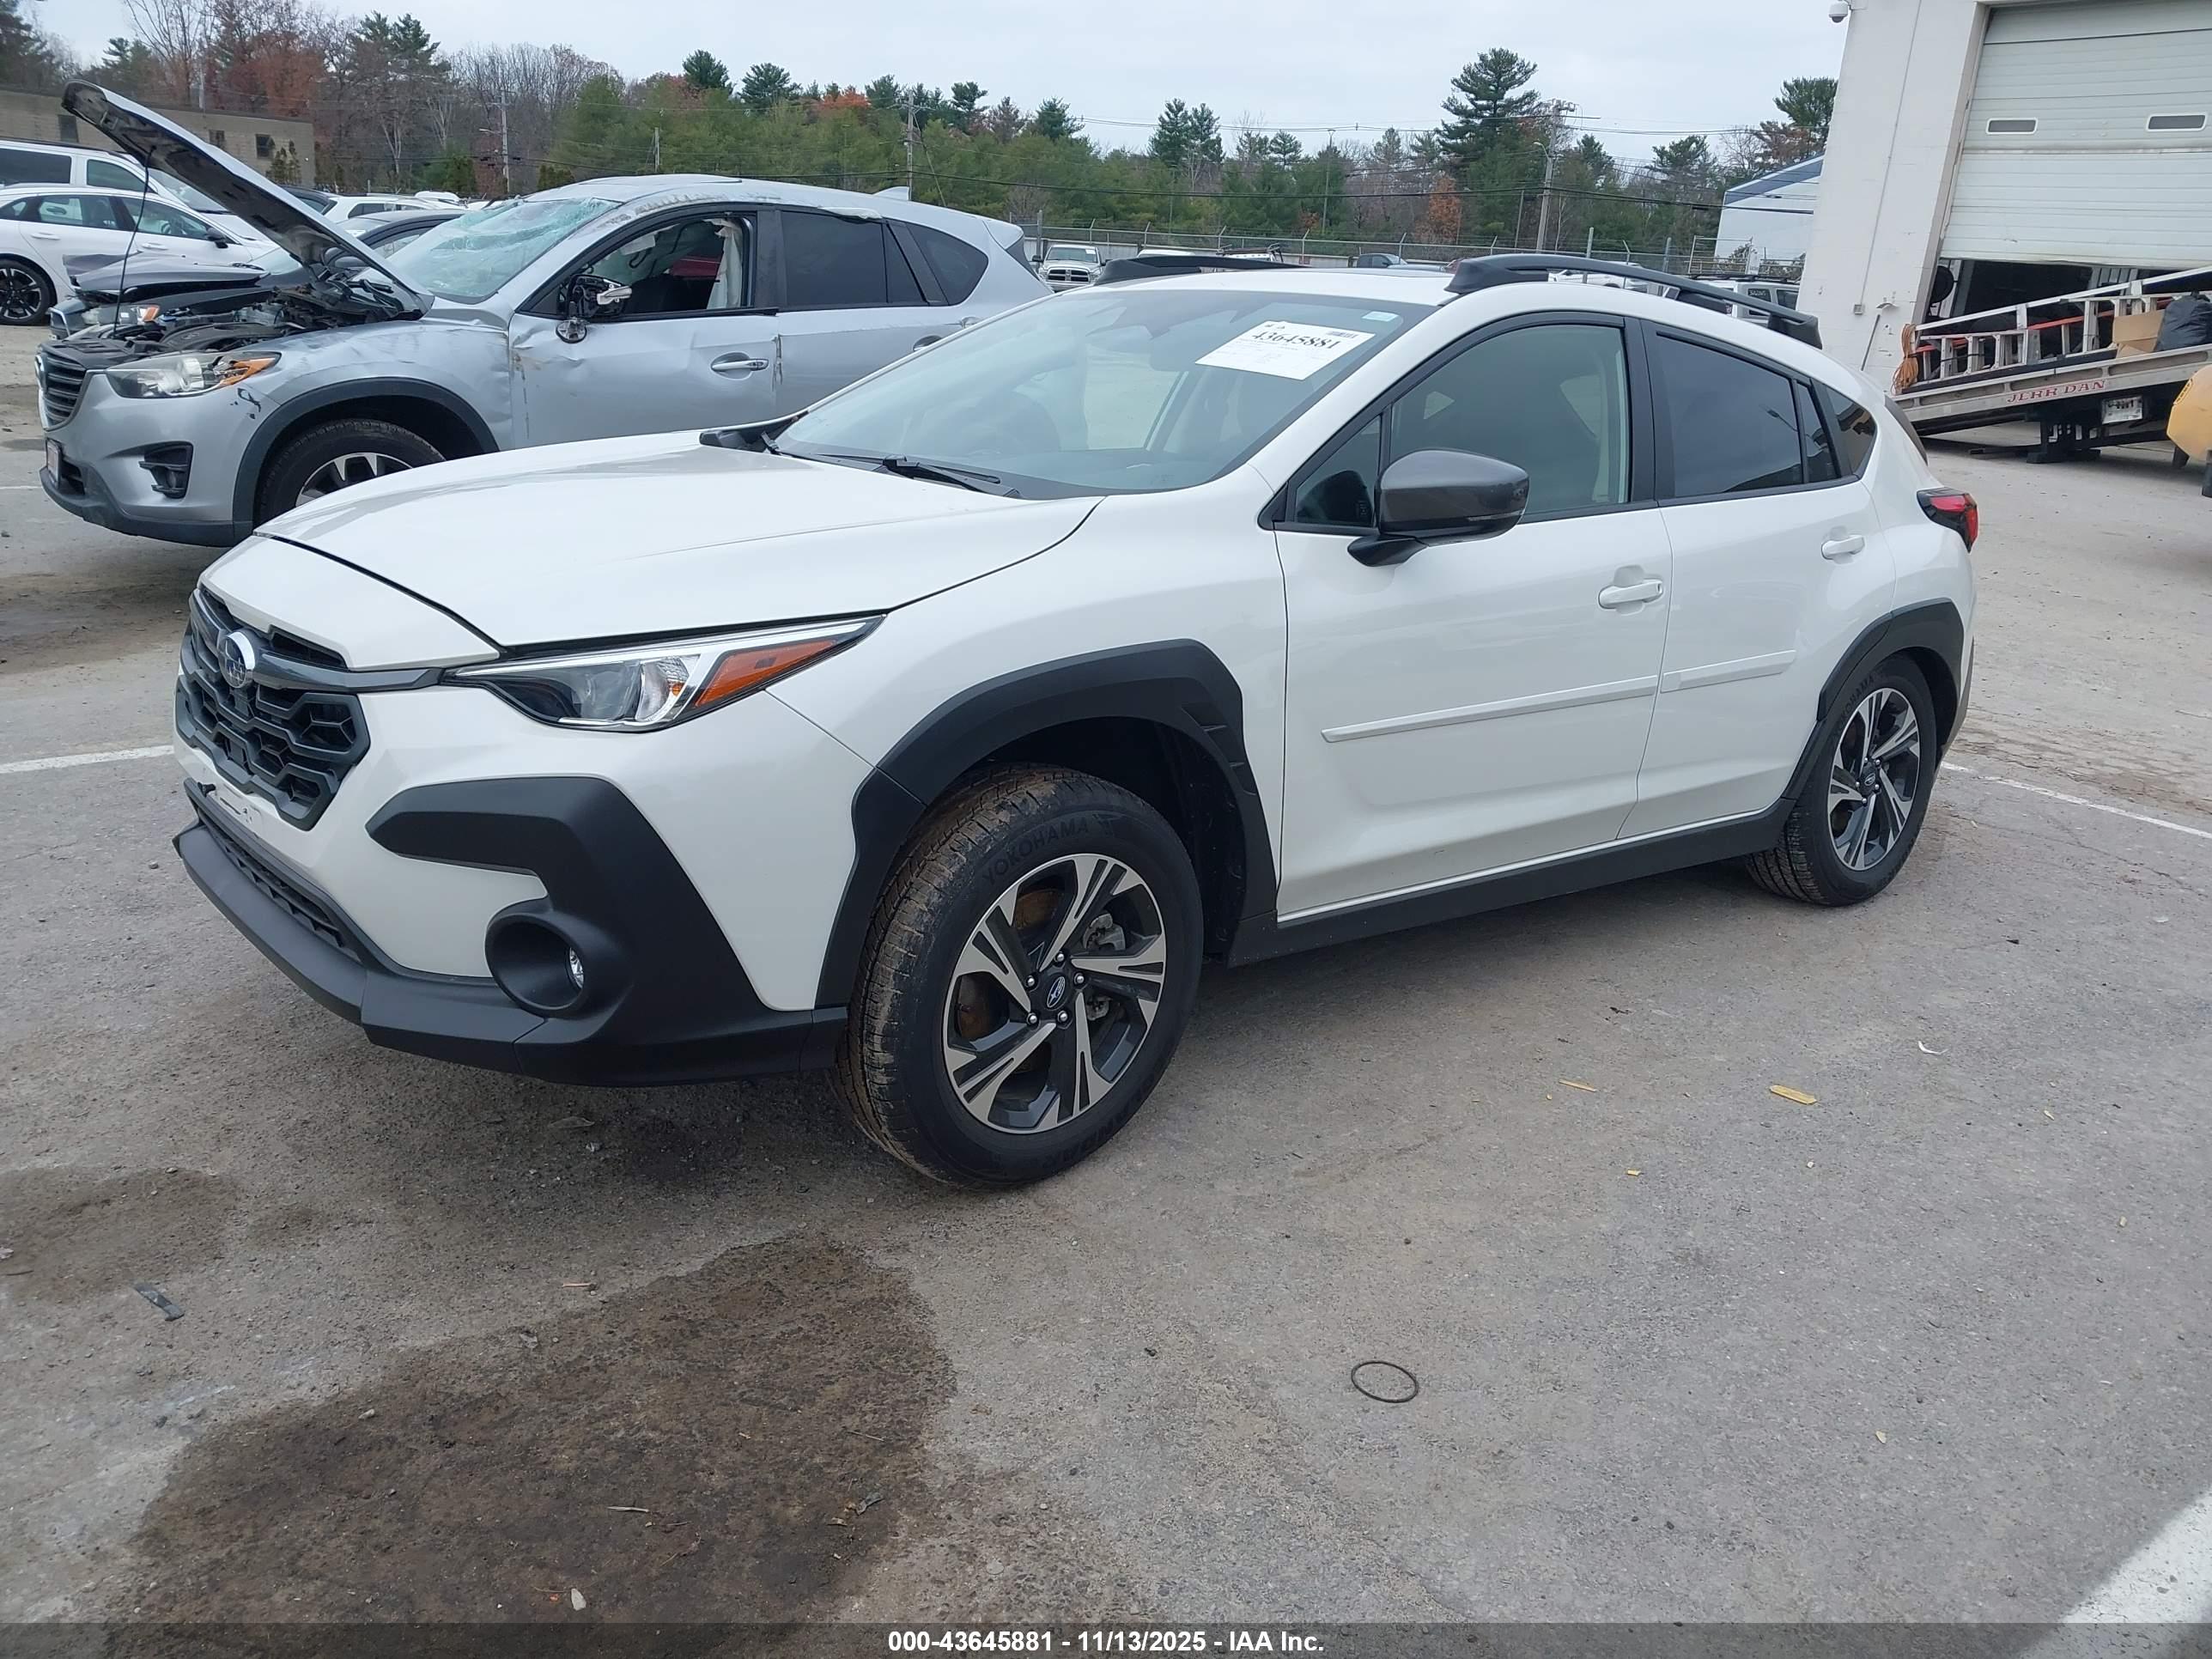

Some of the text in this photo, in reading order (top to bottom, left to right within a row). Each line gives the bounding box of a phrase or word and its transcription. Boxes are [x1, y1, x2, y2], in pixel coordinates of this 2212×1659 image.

[1251, 331, 1341, 349] 43645881
[2063, 380, 2106, 395] DAN
[981, 816, 1091, 885] YOKOHAMA
